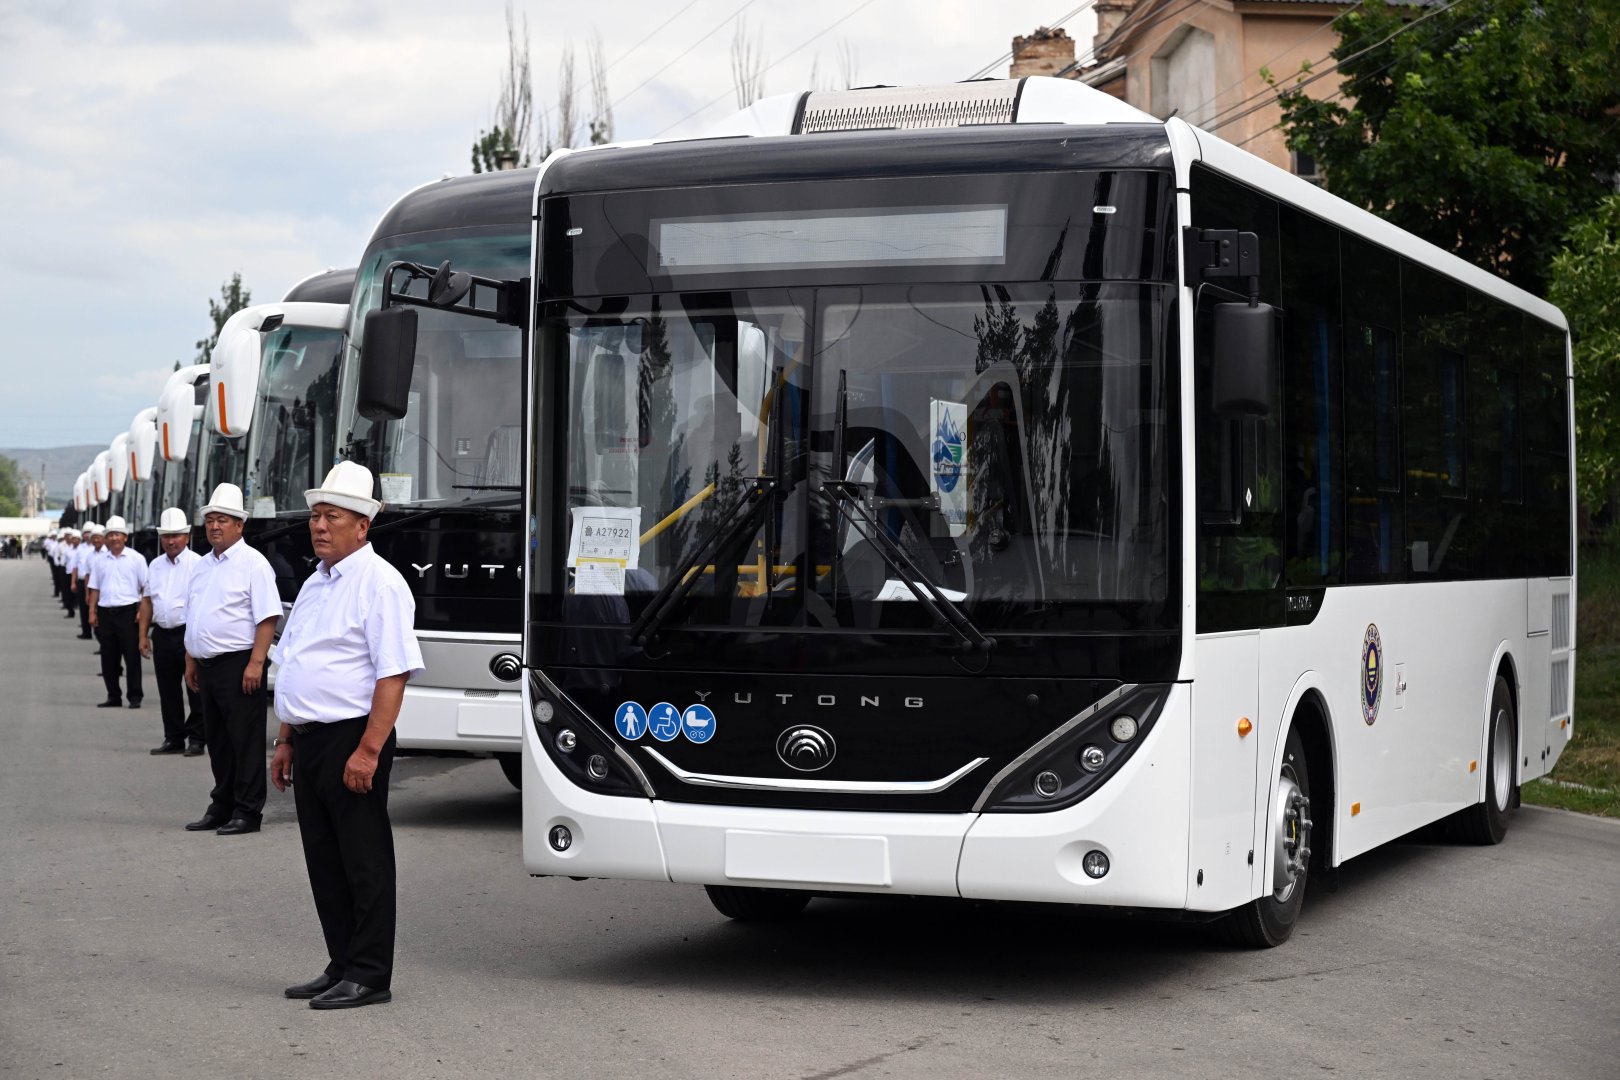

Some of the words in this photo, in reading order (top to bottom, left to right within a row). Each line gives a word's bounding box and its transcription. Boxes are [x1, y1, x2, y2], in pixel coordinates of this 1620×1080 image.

[596, 527, 629, 538] A27922
[411, 563, 522, 579] YUT
[695, 690, 924, 708] YUTONG
